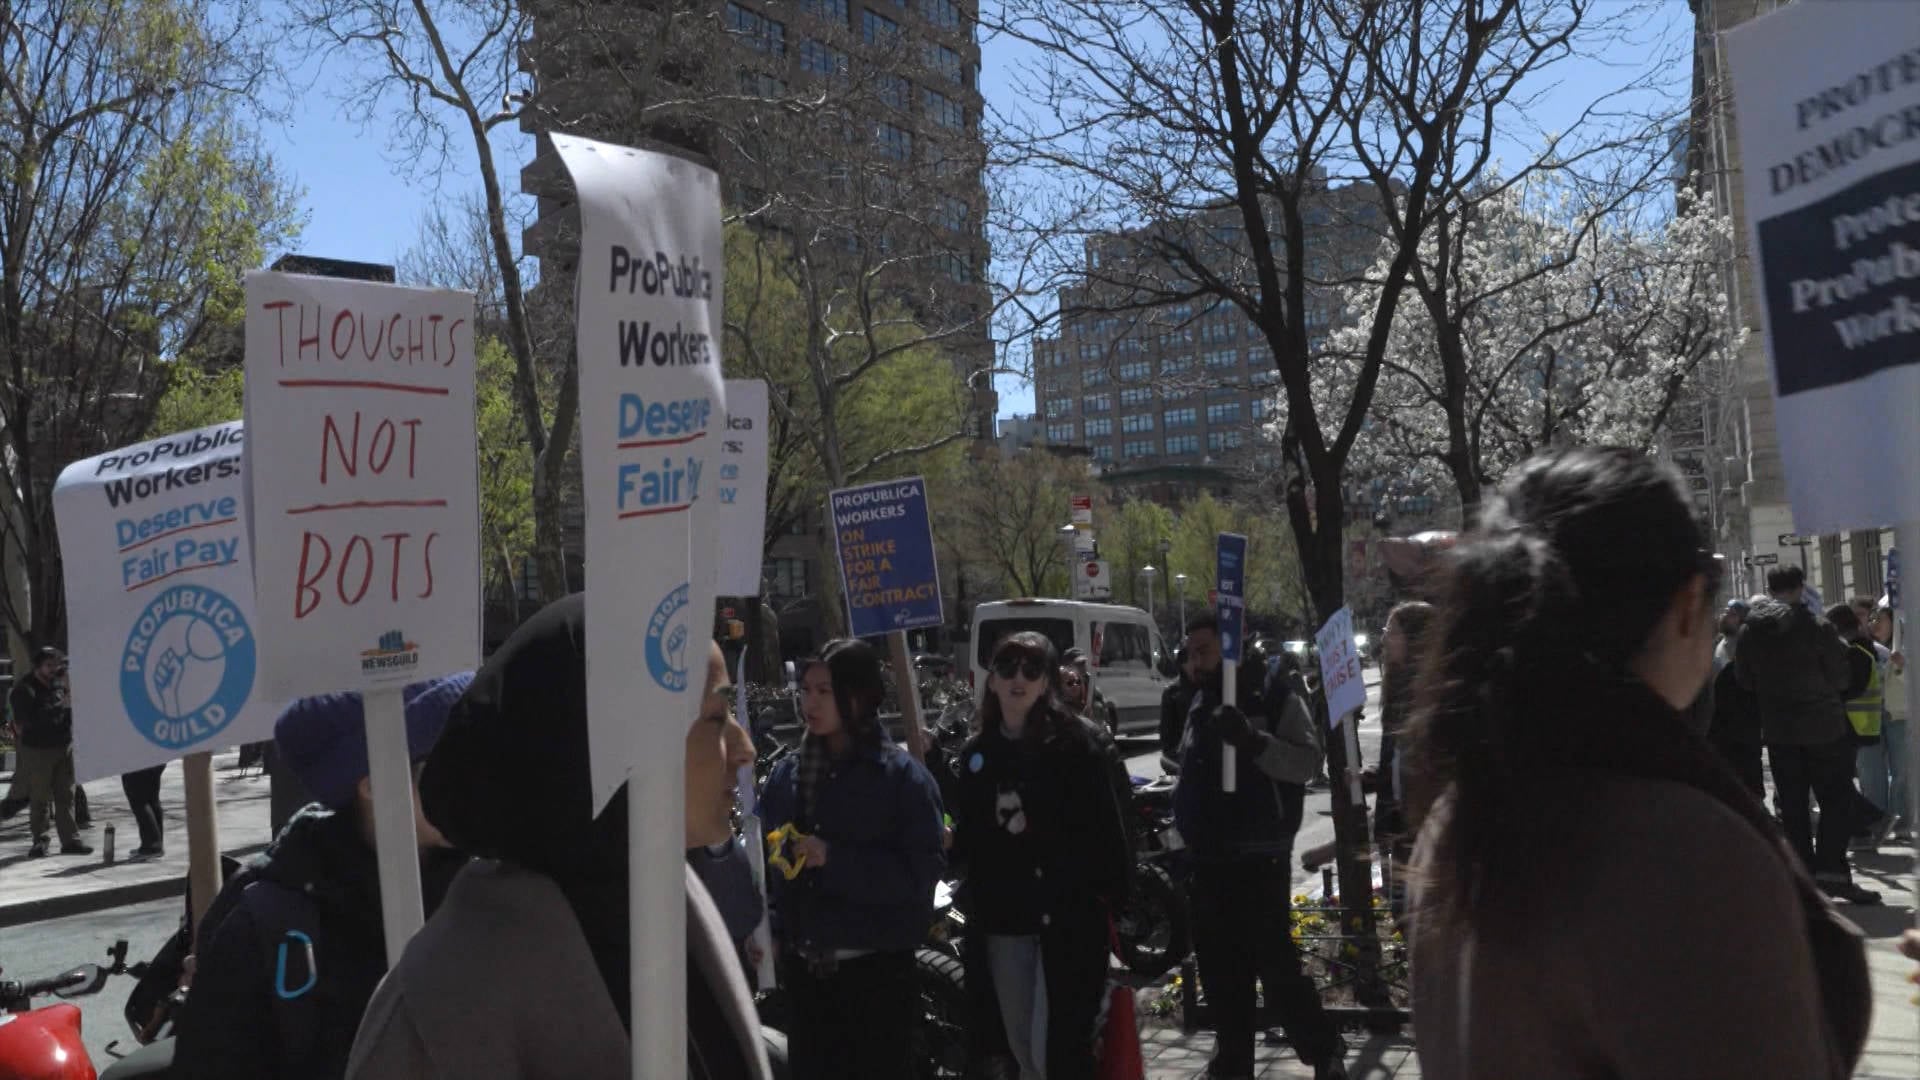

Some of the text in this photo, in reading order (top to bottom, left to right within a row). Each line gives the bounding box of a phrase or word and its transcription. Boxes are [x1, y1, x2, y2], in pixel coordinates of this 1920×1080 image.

[1796, 48, 1920, 130] PROTE
[1769, 104, 1920, 196] DEMOCR
[1832, 193, 1920, 249] Prote
[1790, 242, 1920, 313] ProPub
[263, 301, 465, 367] THOUGHTS
[1832, 296, 1920, 349] Work
[95, 427, 243, 477] ProPublic
[320, 412, 422, 484] NOT
[104, 456, 241, 508] Workers:
[617, 457, 684, 510] Fair
[834, 485, 920, 509] PROPUBLICA
[116, 496, 237, 547] Deserve
[837, 504, 906, 527] WORKERS
[841, 529, 864, 544] ON
[122, 536, 239, 587] Fair Pay
[295, 531, 440, 619] BOTS
[843, 539, 896, 561] STRIKE
[846, 557, 892, 577] FOR A
[848, 575, 881, 592] FAIR
[852, 583, 935, 609] CONTRACT
[125, 590, 246, 672] PROPUBLICA
[361, 652, 419, 670] NEWSGUILD
[154, 703, 226, 743] GUILD
